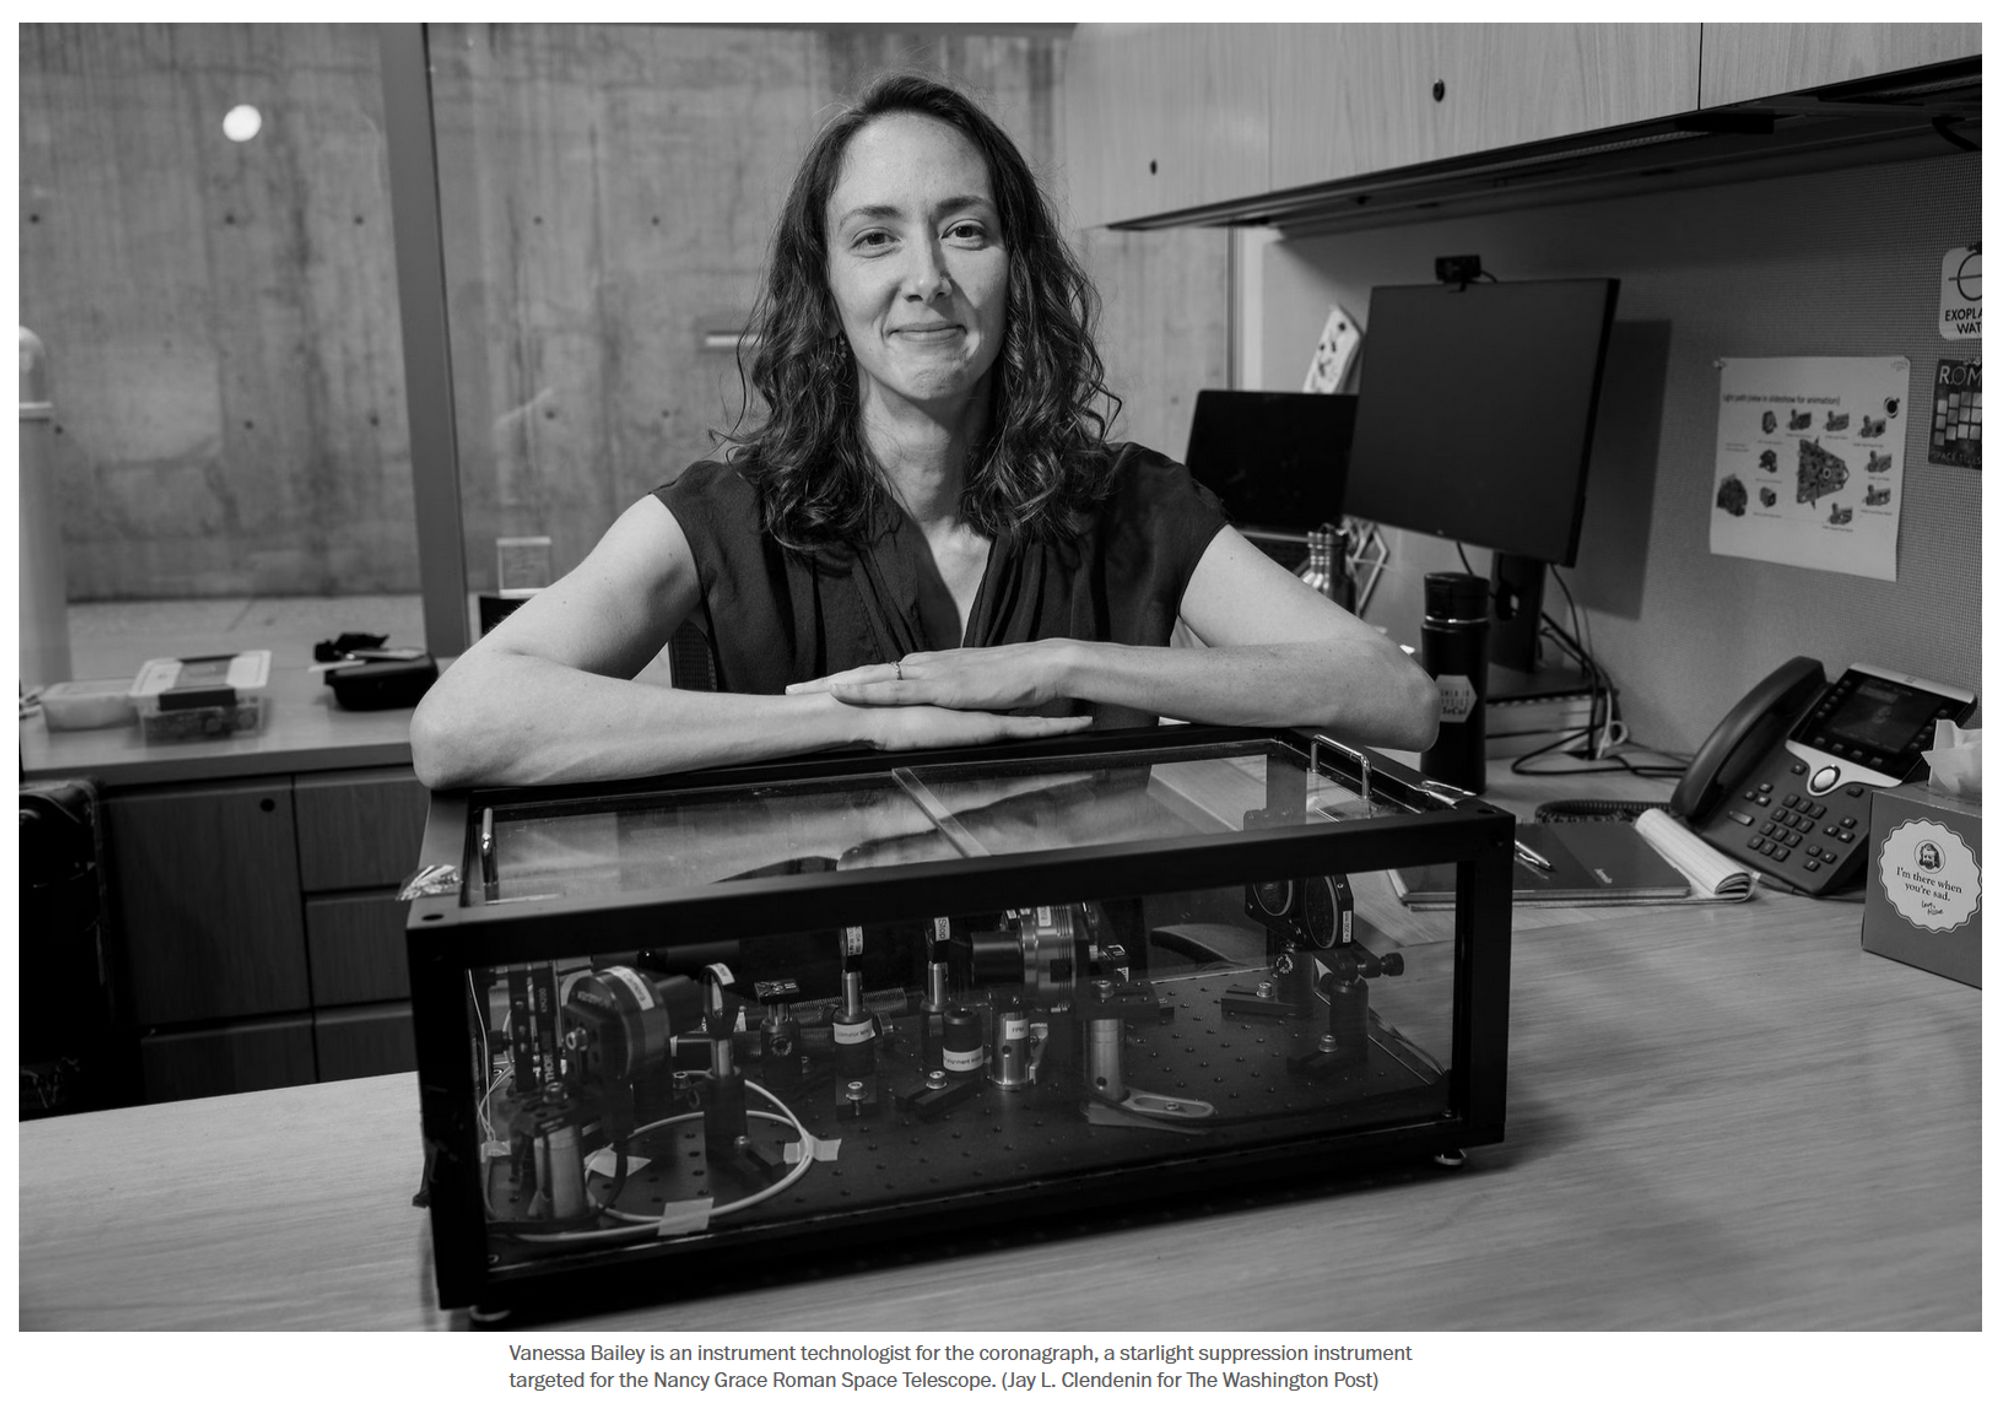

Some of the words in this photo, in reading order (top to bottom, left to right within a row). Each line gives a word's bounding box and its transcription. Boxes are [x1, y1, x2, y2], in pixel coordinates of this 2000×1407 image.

[1956, 322, 1982, 335] WAT
[1896, 866, 1911, 879] I'm
[1912, 872, 1936, 887] there
[1937, 880, 1962, 894] when
[1905, 883, 1932, 897] you're
[1933, 889, 1951, 902] sad.
